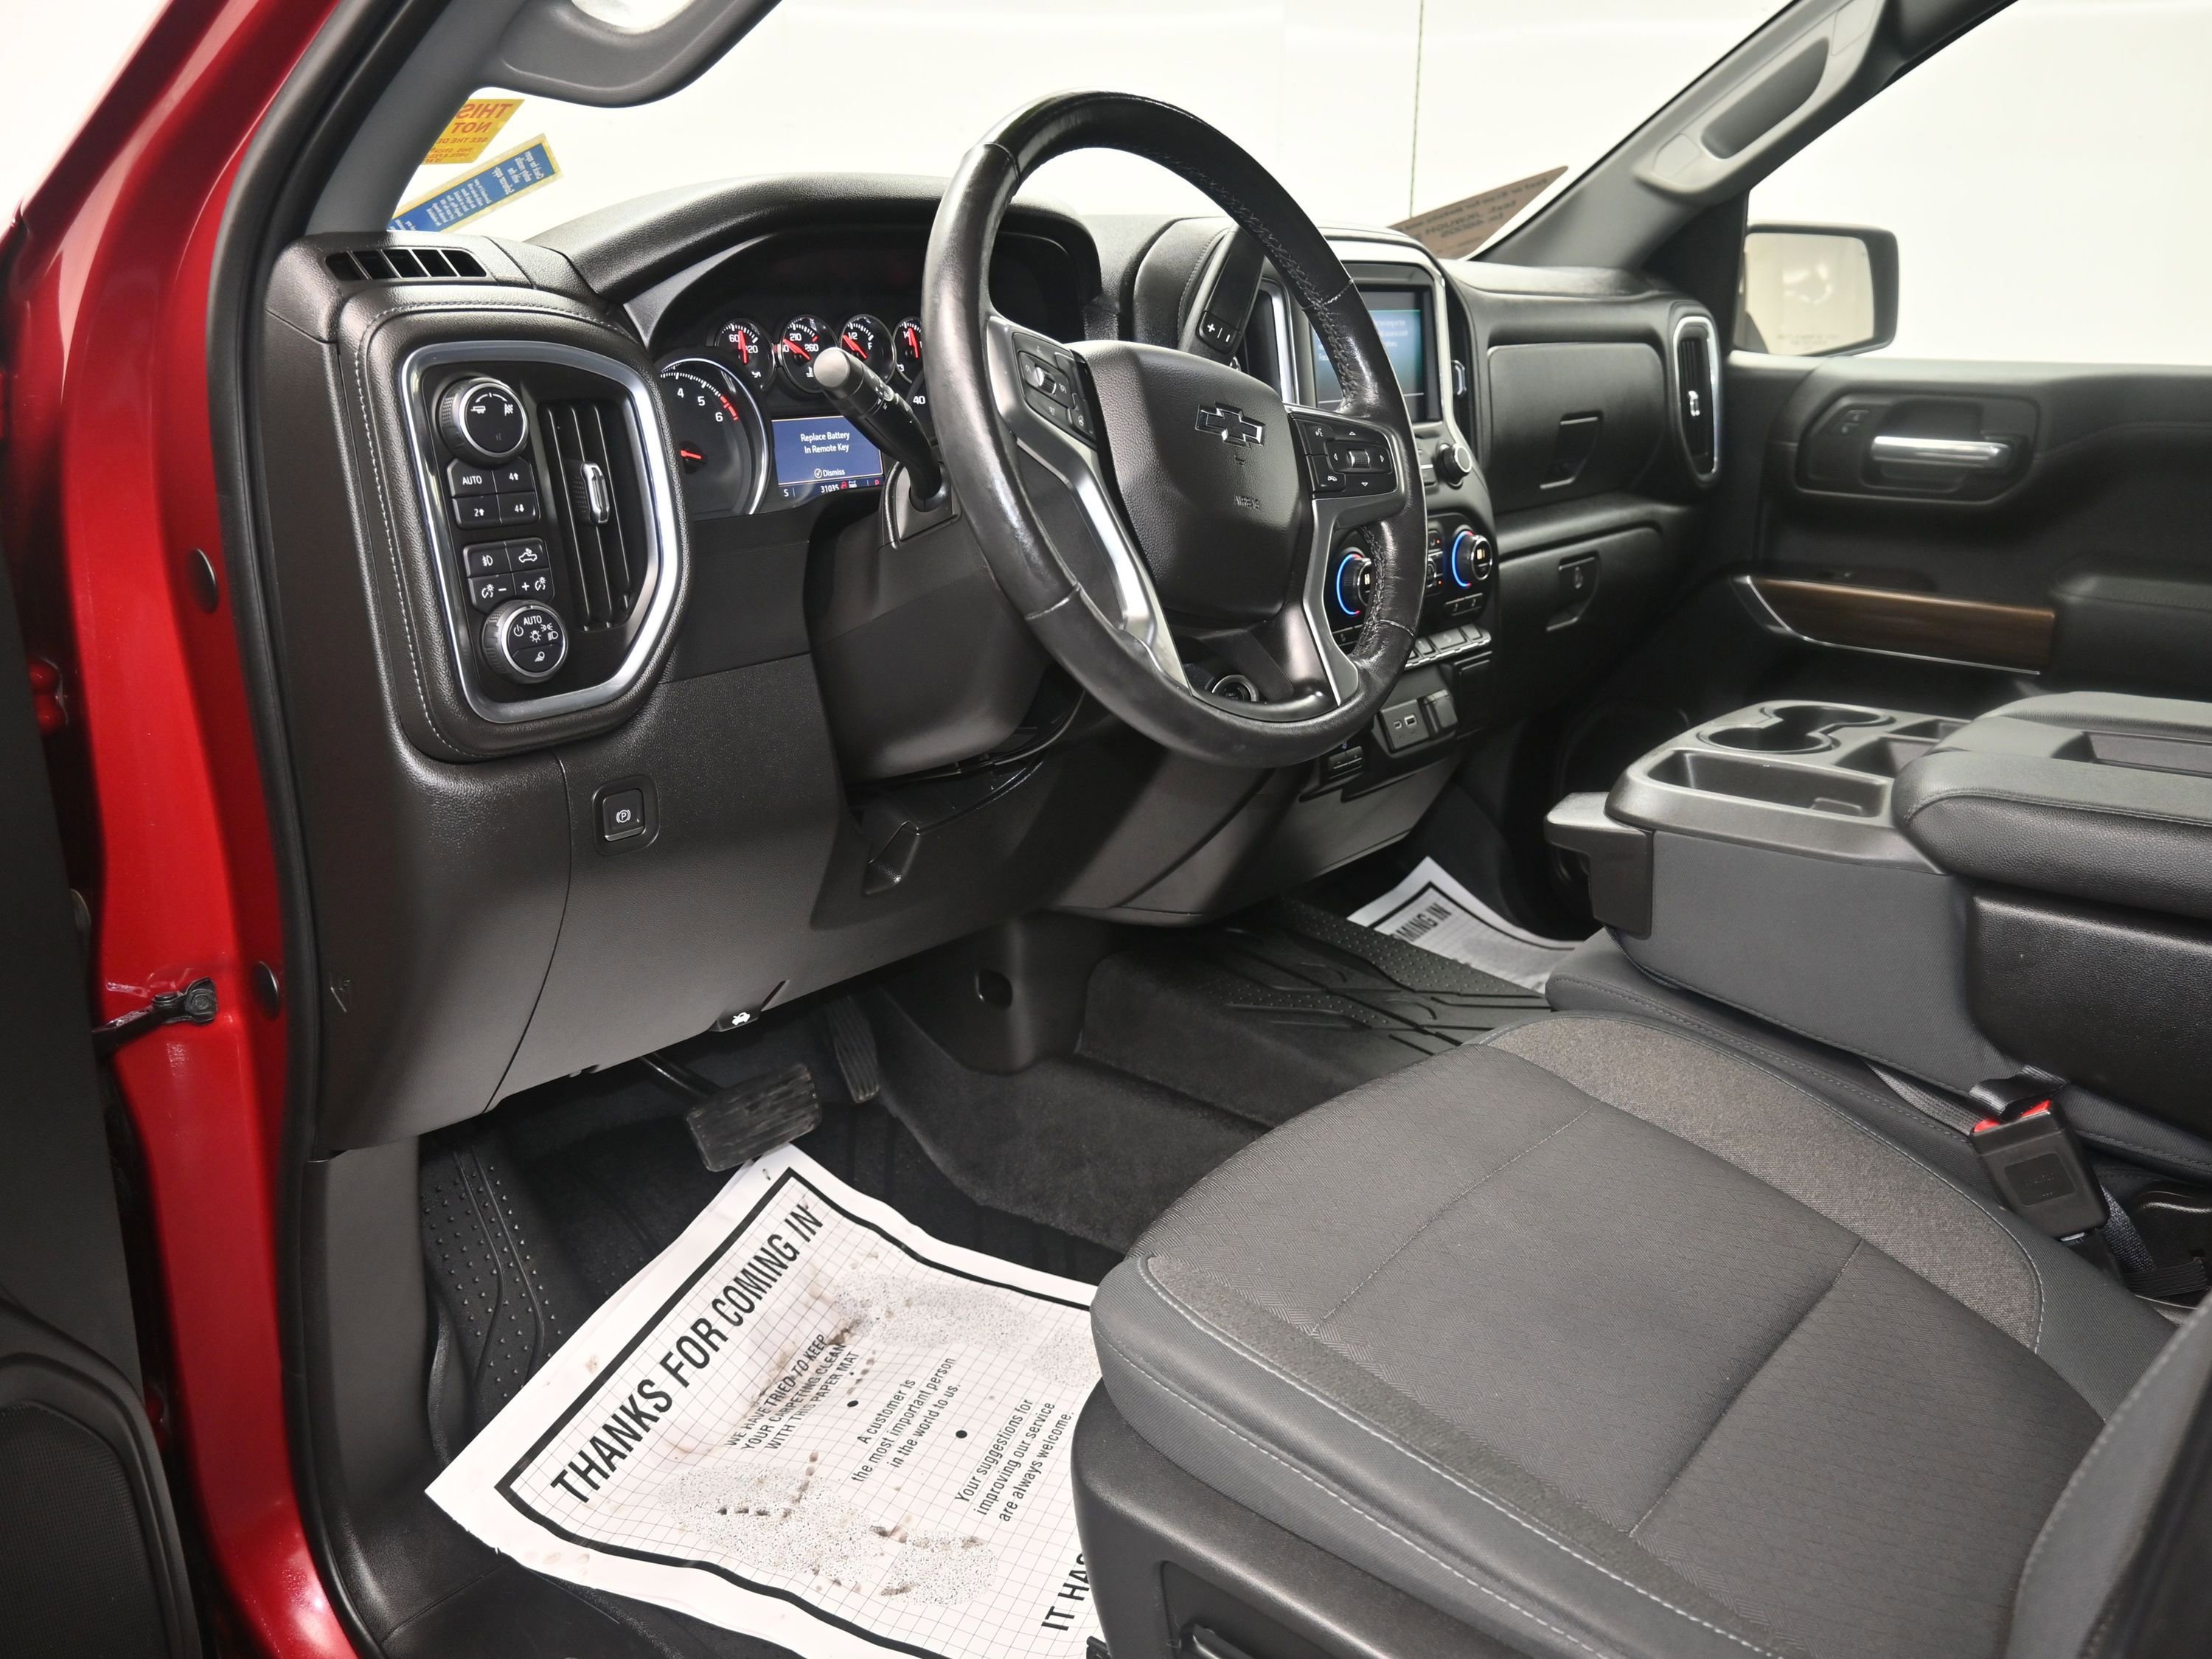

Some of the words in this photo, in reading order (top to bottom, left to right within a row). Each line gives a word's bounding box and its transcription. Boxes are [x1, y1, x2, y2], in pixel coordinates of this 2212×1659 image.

[789, 333, 802, 341] 210
[867, 342, 873, 350] F
[677, 388, 684, 398] 4
[697, 395, 706, 406] 5
[913, 396, 926, 405] 40
[714, 411, 723, 422] 6
[800, 433, 826, 443] Replace
[827, 431, 850, 441] Battery
[804, 445, 811, 453] In
[812, 444, 837, 453] Remote
[837, 443, 849, 453] Key
[462, 476, 482, 485] AUTO
[822, 468, 845, 477] Dismiss
[783, 488, 789, 497] S
[820, 483, 840, 493] 31035
[523, 615, 543, 625] AUTO
[1425, 902, 1452, 921] IN
[550, 1379, 672, 1503] THANKS
[658, 1318, 728, 1388] FOR
[711, 1234, 800, 1327] COMING
[784, 1203, 823, 1243] IN
[724, 1431, 747, 1447] WE
[740, 1407, 771, 1430] HAVE
[764, 1376, 796, 1407] TRIED
[791, 1359, 810, 1377] TO
[803, 1334, 827, 1362] KEEP
[741, 1424, 775, 1450] YOUR
[768, 1377, 821, 1422] CARPETING
[815, 1343, 846, 1376] CLEAN
[765, 1424, 796, 1450] WITH
[788, 1404, 816, 1422] THIS
[811, 1373, 843, 1402] PAPER
[836, 1351, 860, 1373] MAT
[851, 1464, 873, 1482] the
[869, 1437, 895, 1464] most
[886, 1390, 931, 1437] important
[925, 1357, 956, 1391] person
[856, 1436, 872, 1444] A
[866, 1389, 908, 1435] customer
[899, 1380, 916, 1389] is
[886, 1457, 905, 1468] in
[897, 1439, 918, 1456] the
[913, 1409, 940, 1438] world
[933, 1399, 949, 1410] to
[943, 1384, 961, 1398] us.
[955, 1475, 982, 1503] Your
[976, 1414, 1023, 1475] suggestions
[1015, 1399, 1033, 1414] for
[973, 1459, 1022, 1516] improving
[1013, 1439, 1031, 1458] our
[1026, 1402, 1055, 1439] service
[999, 1500, 1018, 1522] are
[1012, 1460, 1043, 1500] always
[1036, 1411, 1075, 1459] welcome.
[1040, 1605, 1075, 1631] IT
